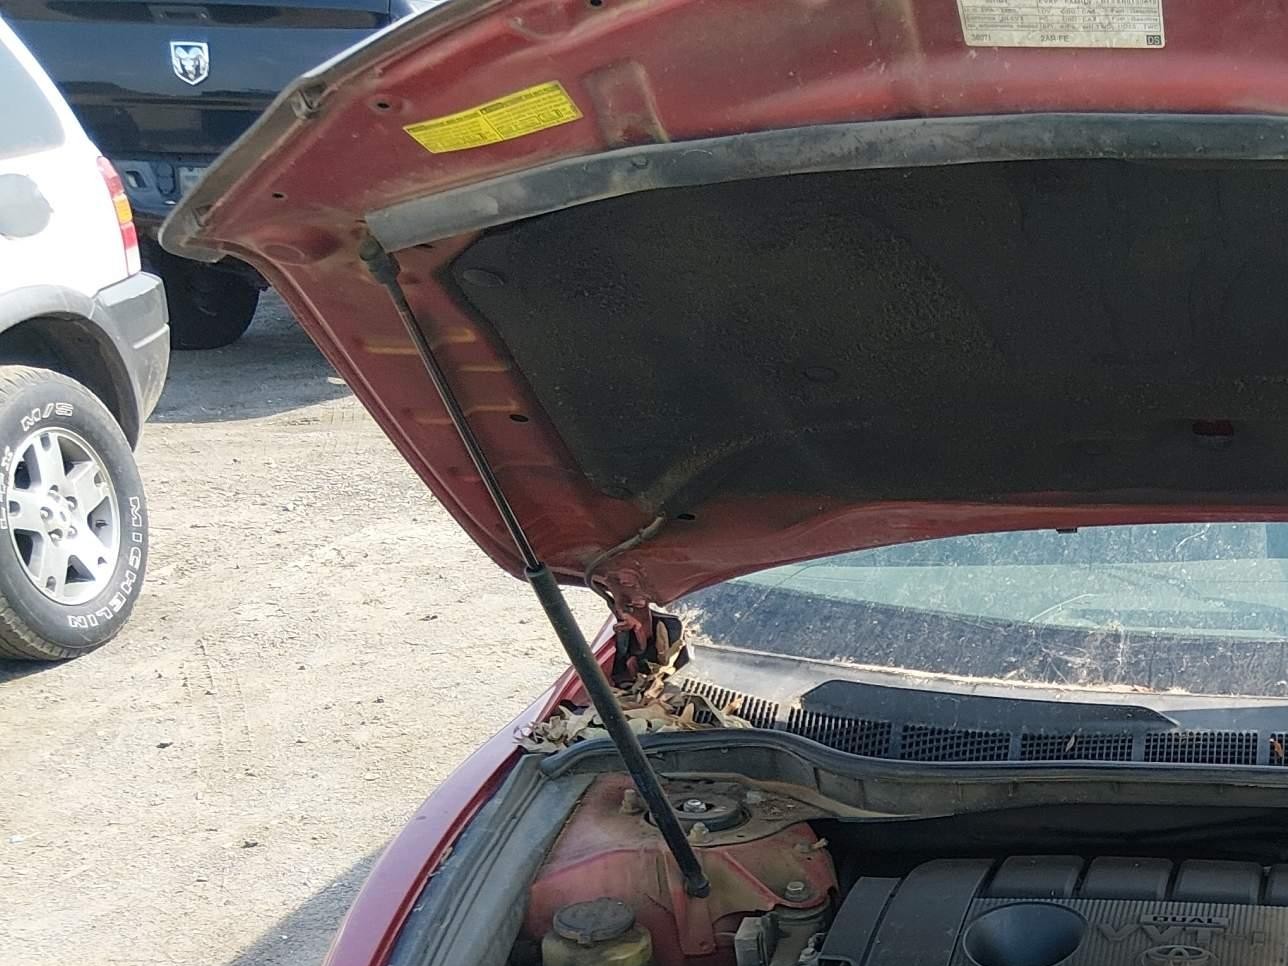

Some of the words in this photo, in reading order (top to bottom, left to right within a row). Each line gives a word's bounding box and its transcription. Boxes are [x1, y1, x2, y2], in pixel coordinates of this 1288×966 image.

[1147, 36, 1161, 45] DS
[20, 402, 74, 432] M/S
[67, 495, 144, 629] MICHELIN
[1152, 915, 1222, 925] DUAL
[1097, 922, 1266, 946] VVT-i
